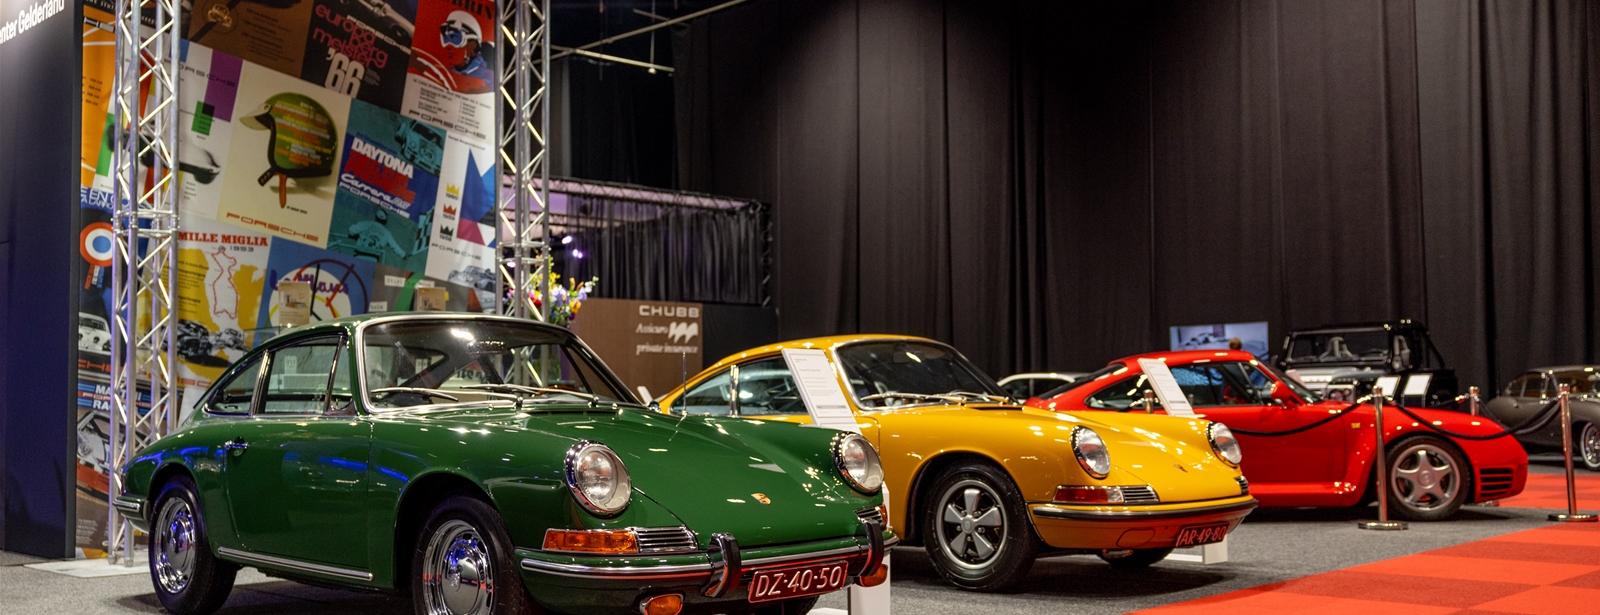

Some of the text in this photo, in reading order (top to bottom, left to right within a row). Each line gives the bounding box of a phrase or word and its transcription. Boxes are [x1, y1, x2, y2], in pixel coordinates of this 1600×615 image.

[18, 0, 65, 34] Gelderland
[315, 4, 376, 46] europa
[346, 14, 412, 55] PORSCHE
[408, 108, 487, 140] PORSCHE
[350, 136, 414, 179] DAYTONA
[338, 181, 410, 219] PORSCHE
[340, 172, 392, 204] Carrera
[177, 231, 268, 247] MILLE MIGLIA
[226, 211, 319, 243] PORSCHE
[431, 242, 482, 261] PORSCHE
[638, 304, 700, 319] CHUBB
[635, 342, 662, 356] private
[1179, 525, 1227, 546] AR-49-80
[755, 565, 842, 598] DZ-40-50
